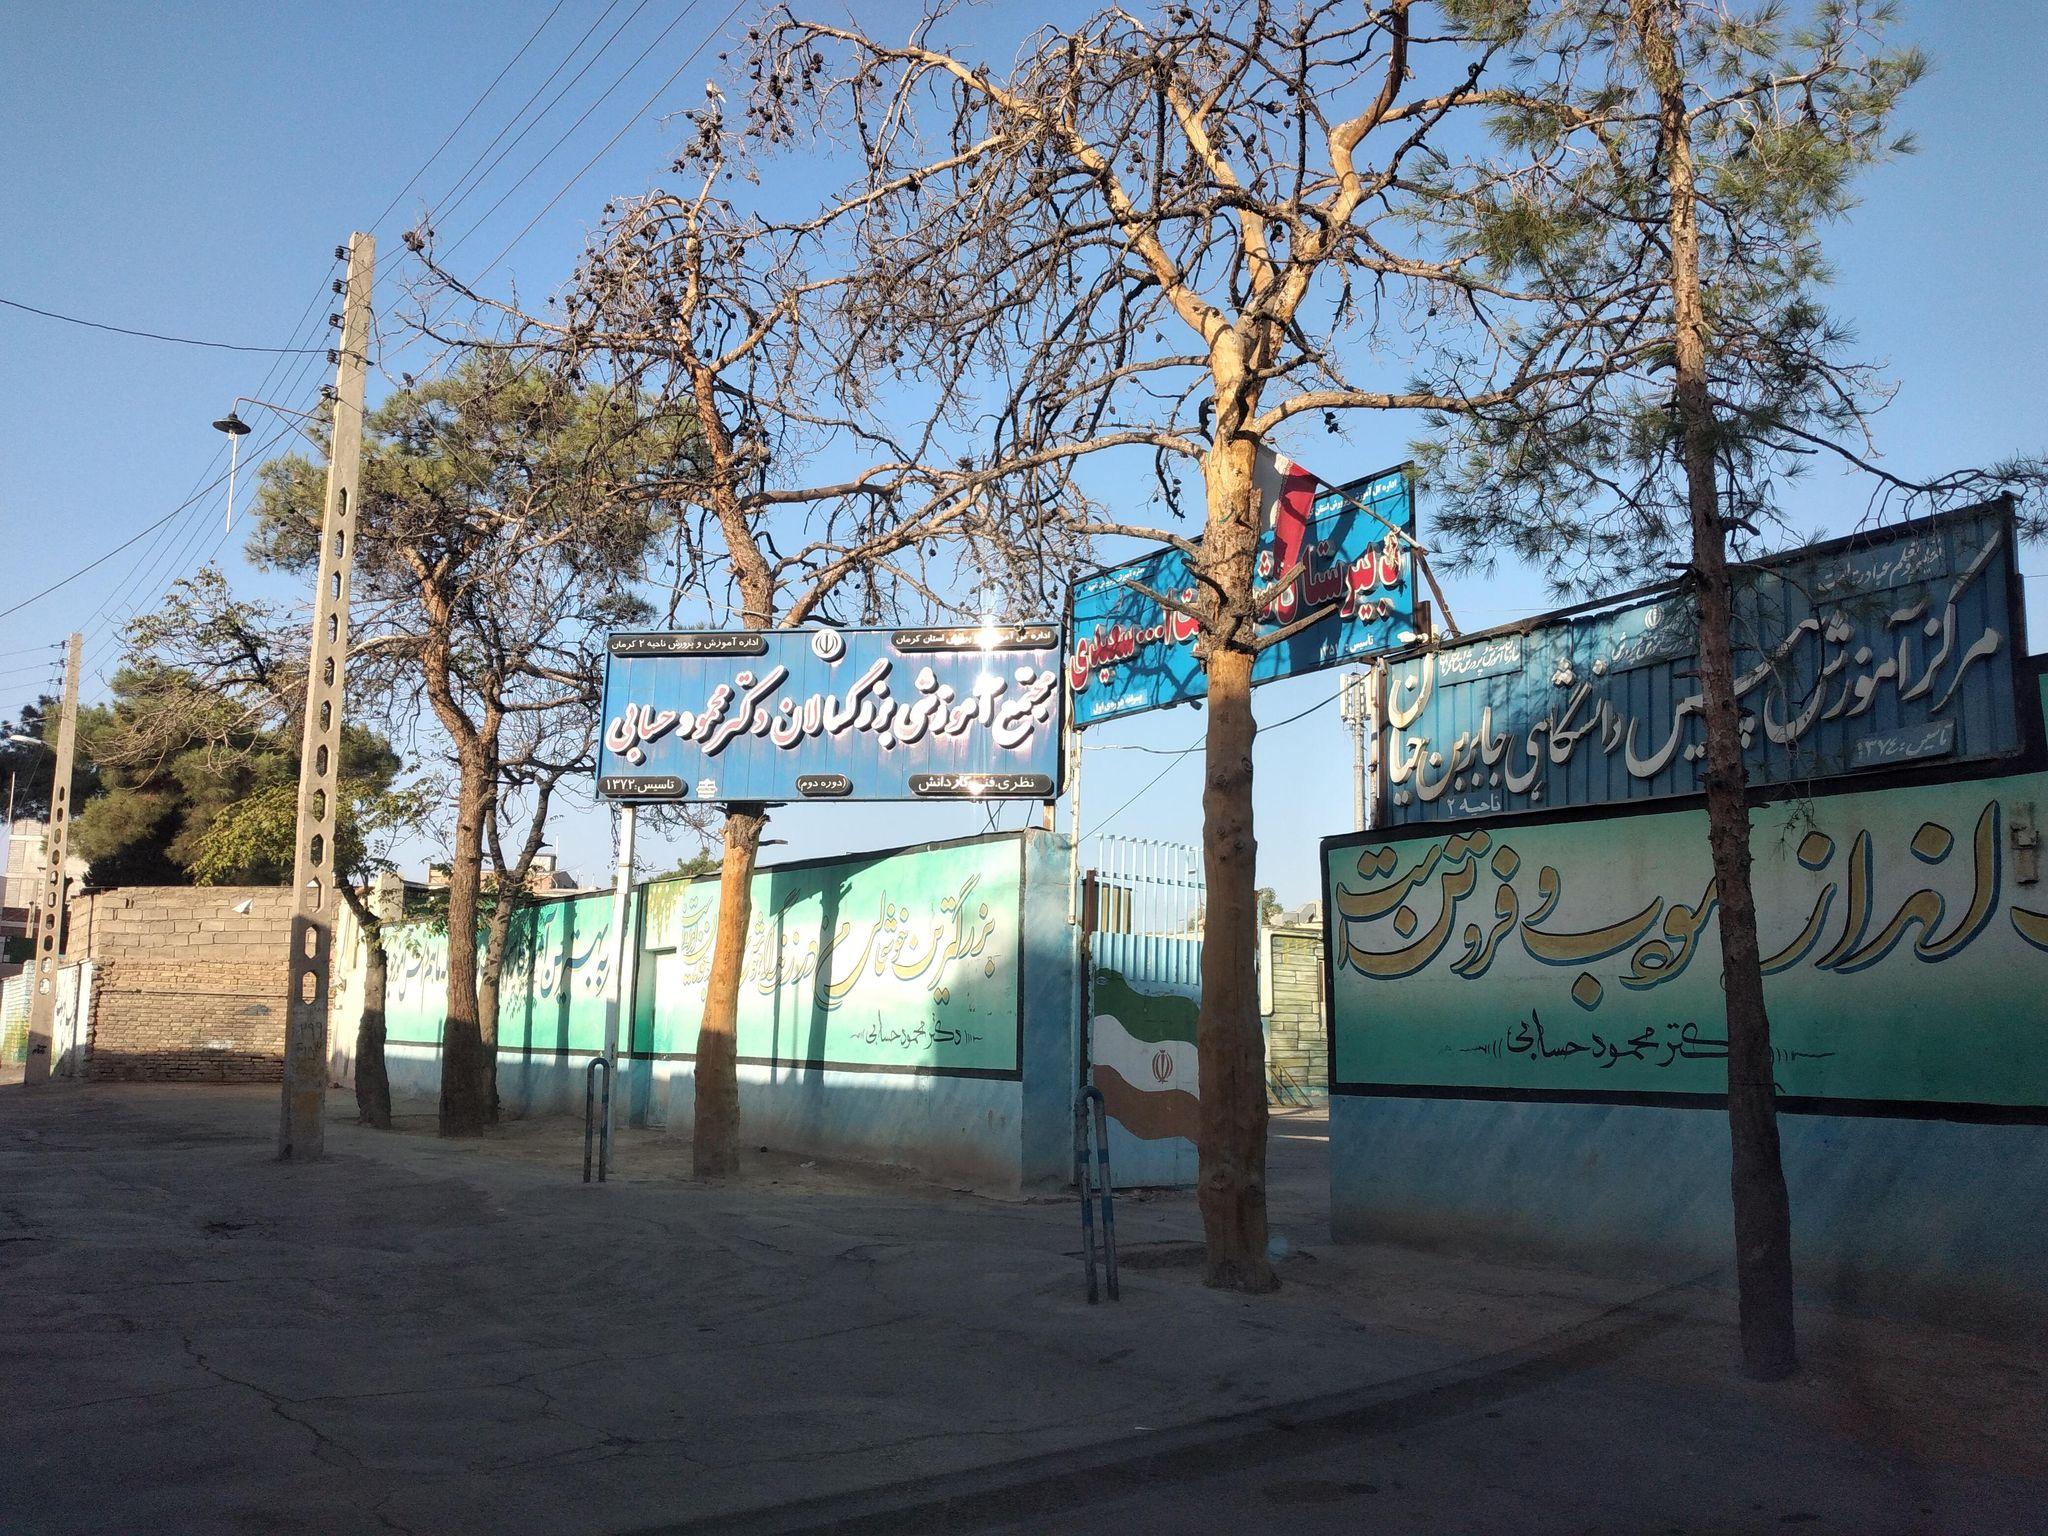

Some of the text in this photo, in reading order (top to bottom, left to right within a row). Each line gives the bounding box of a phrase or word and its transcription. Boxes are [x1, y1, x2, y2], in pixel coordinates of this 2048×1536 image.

[611, 636, 760, 651] اداره آموزش و پرورش ناحیه ۲ کرمان
[895, 635, 921, 646] کرمان
[1903, 530, 2000, 714] مرکز
[604, 656, 1058, 765] مجتمع آموزشی بزرگسالان دکتر محمود حسابی
[1763, 597, 1930, 745] آموزش
[1504, 656, 1625, 800] دانشگاهی
[1459, 792, 1501, 812] ناحیه
[891, 871, 997, 1006] بزرگترین
[865, 1009, 962, 1050] دکتر محمود حسابی
[1507, 1008, 1730, 1069] کتر محمود حسابی
